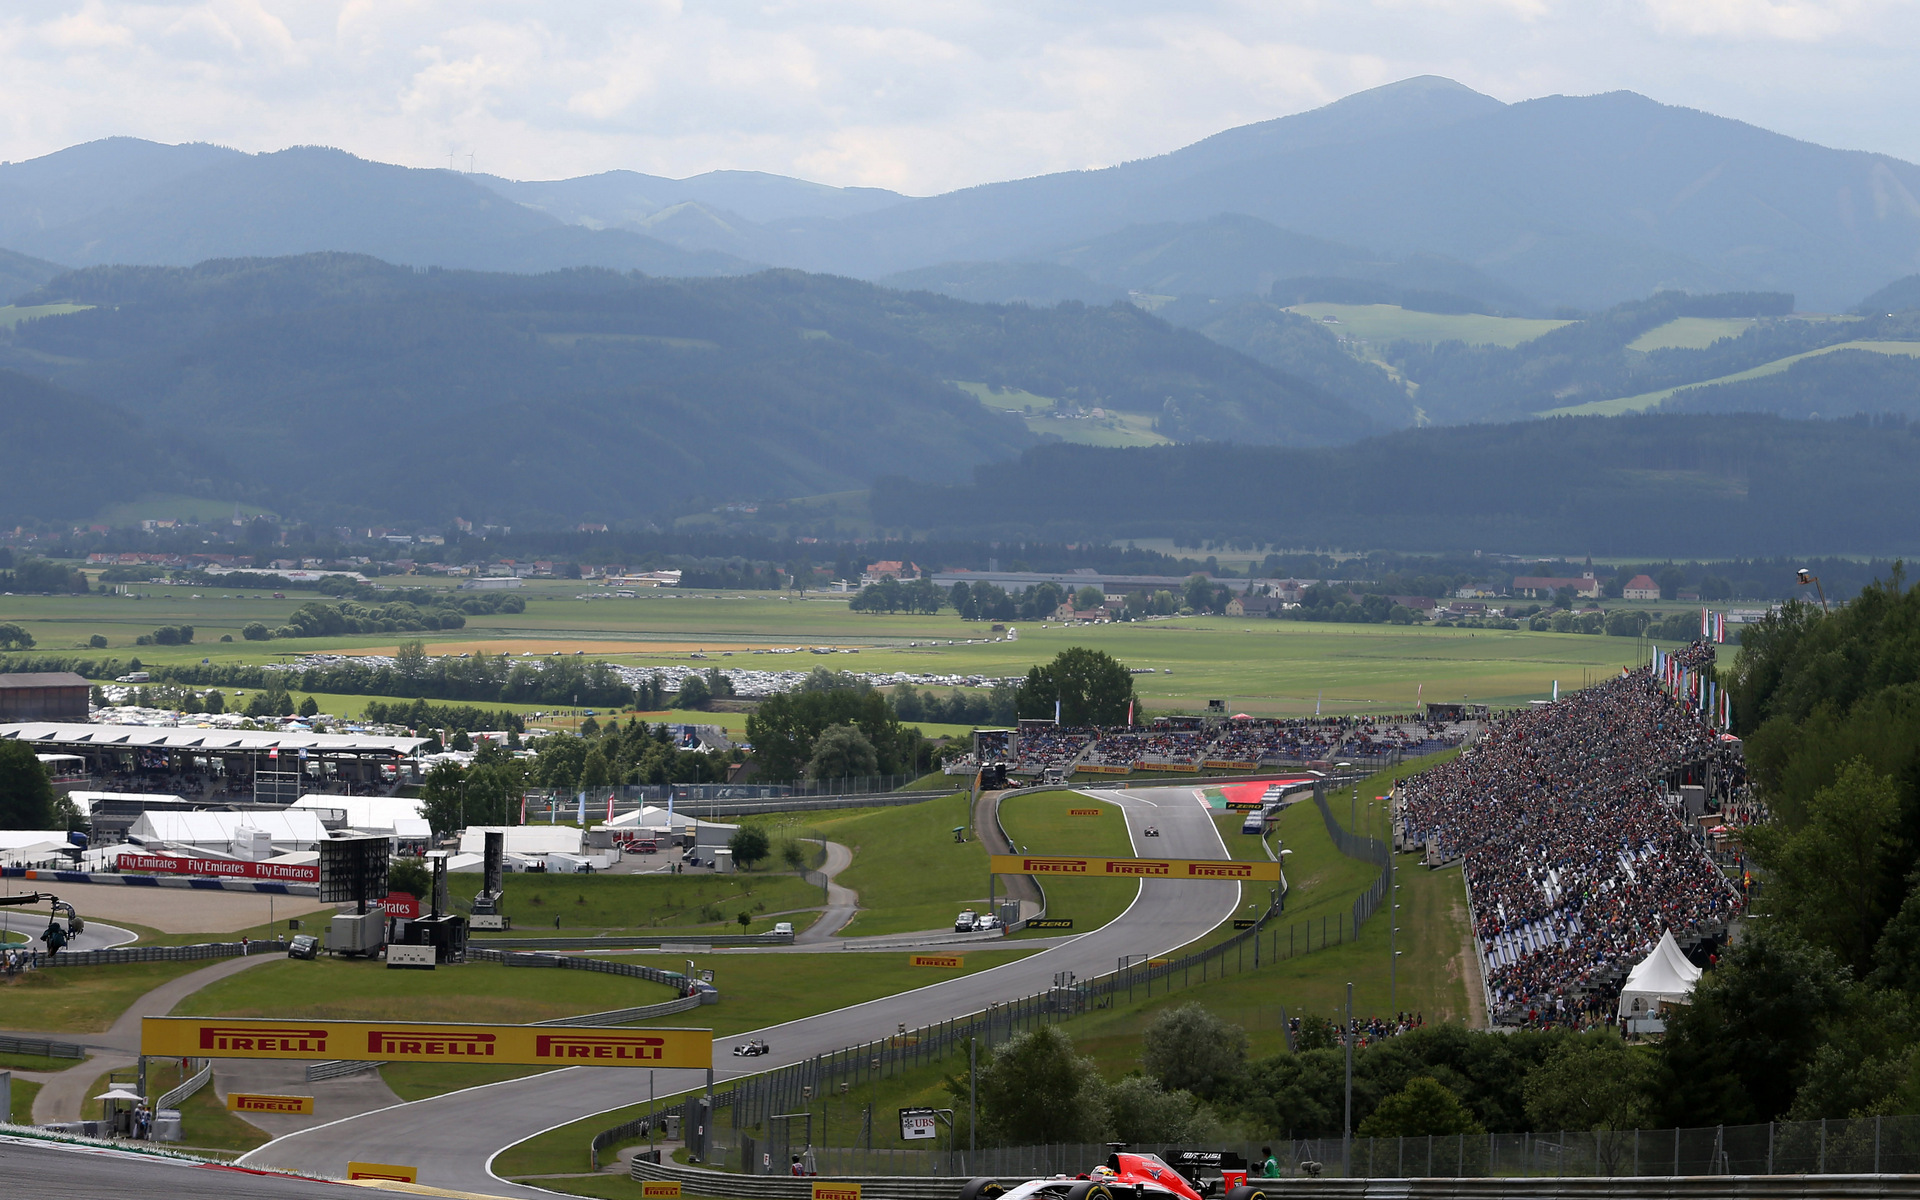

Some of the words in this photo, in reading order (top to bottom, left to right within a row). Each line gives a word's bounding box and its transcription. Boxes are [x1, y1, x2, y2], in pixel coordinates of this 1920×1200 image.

[120, 855, 136, 868] Fly
[138, 857, 177, 869] Emirates
[188, 860, 203, 873] Fly
[205, 861, 245, 874] Emirates
[1024, 859, 1087, 872] PIRELLI
[1106, 861, 1169, 875] PIRELLI
[256, 864, 272, 877] Fly
[274, 865, 314, 878] Emirates
[1189, 864, 1252, 877] PIRELLI
[379, 901, 410, 914] irates
[916, 957, 957, 966] PIRELLI
[200, 1028, 328, 1052] PIRELLI
[368, 1031, 497, 1056] PIRELLI
[536, 1035, 665, 1060] PIRELLI
[238, 1097, 303, 1111] PIRELLI
[915, 1118, 935, 1127] UBS
[645, 1187, 679, 1195] PIRELLI
